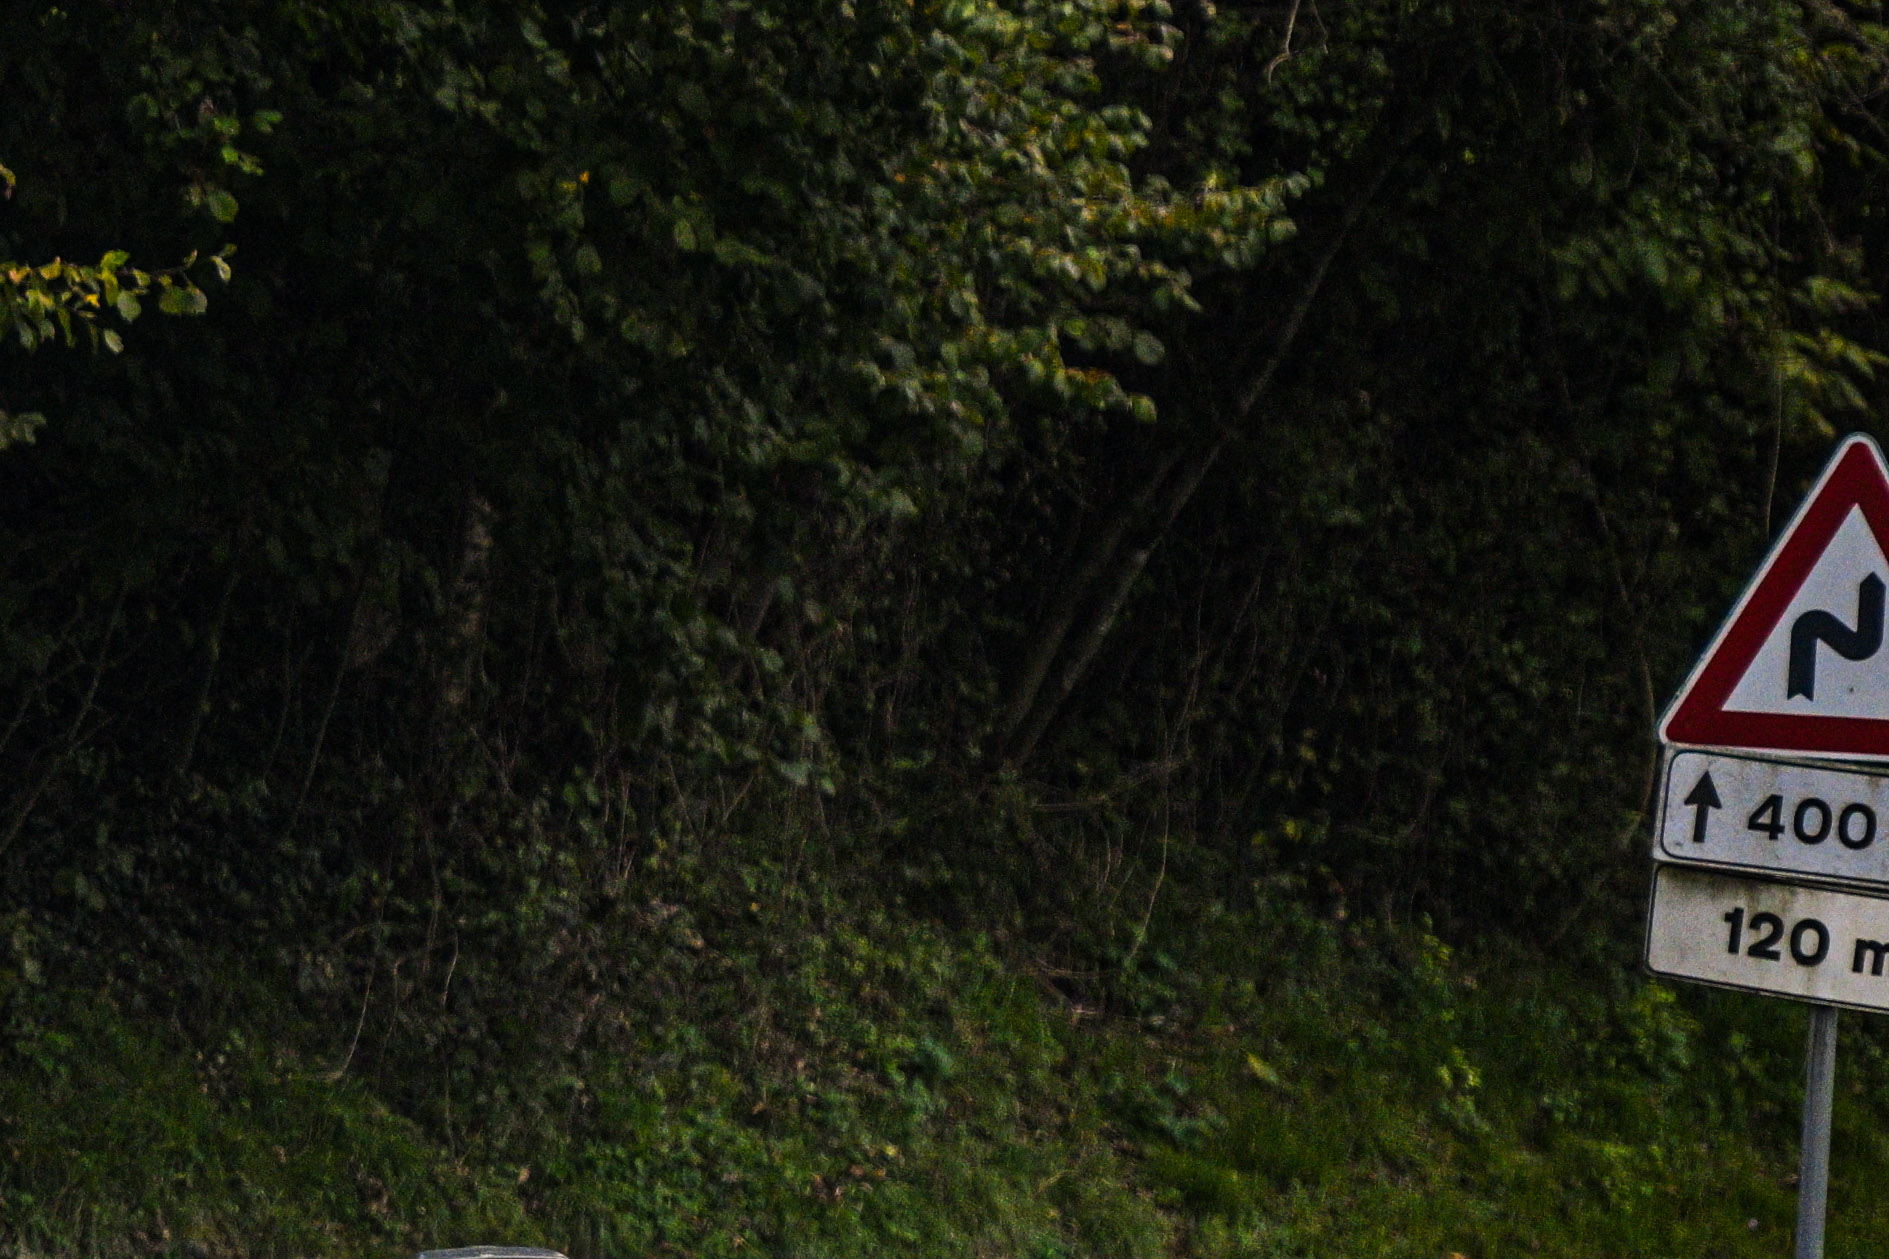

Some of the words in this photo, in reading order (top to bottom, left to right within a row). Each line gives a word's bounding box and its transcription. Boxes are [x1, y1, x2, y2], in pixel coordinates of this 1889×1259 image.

[1748, 794, 1877, 850] 400
[1724, 906, 1831, 968] 120
[1852, 938, 1889, 977] m
